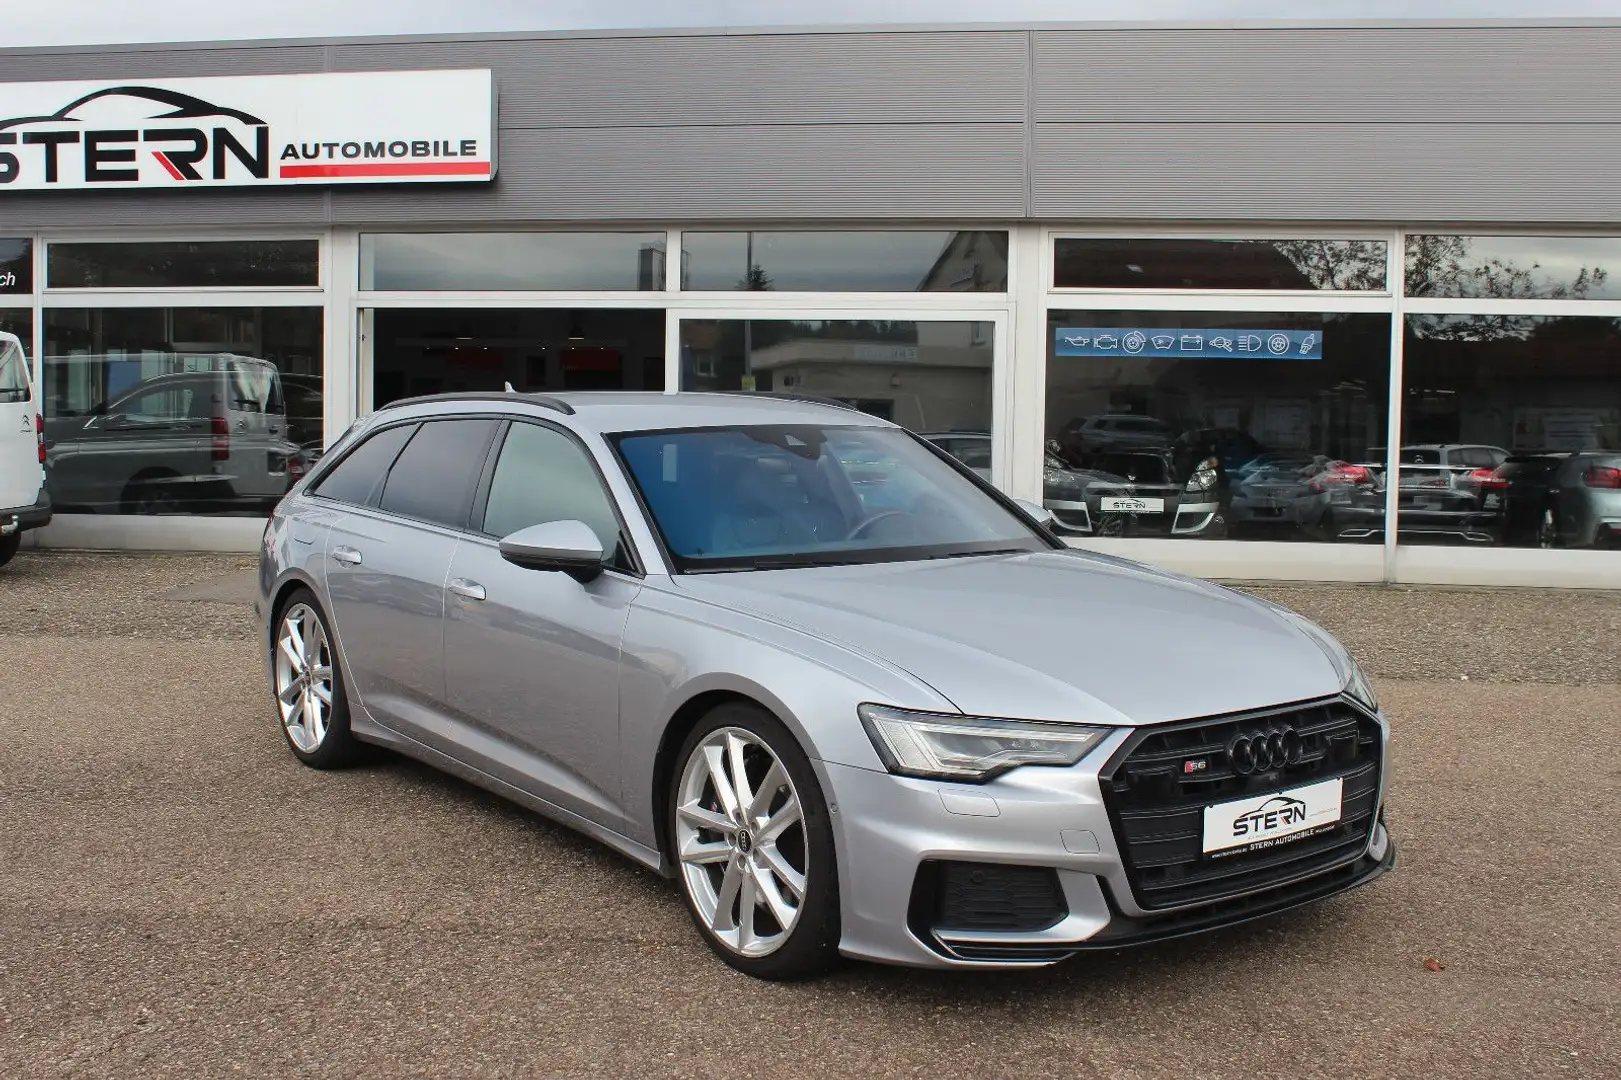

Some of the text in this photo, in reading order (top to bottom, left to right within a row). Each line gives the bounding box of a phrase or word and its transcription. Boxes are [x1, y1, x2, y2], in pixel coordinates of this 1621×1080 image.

[280, 140, 477, 160] AUTOMOBILE
[1233, 805, 1306, 836] STERN
[1249, 839, 1274, 851] STERN
[1275, 829, 1315, 845] AUTOMOBILE
